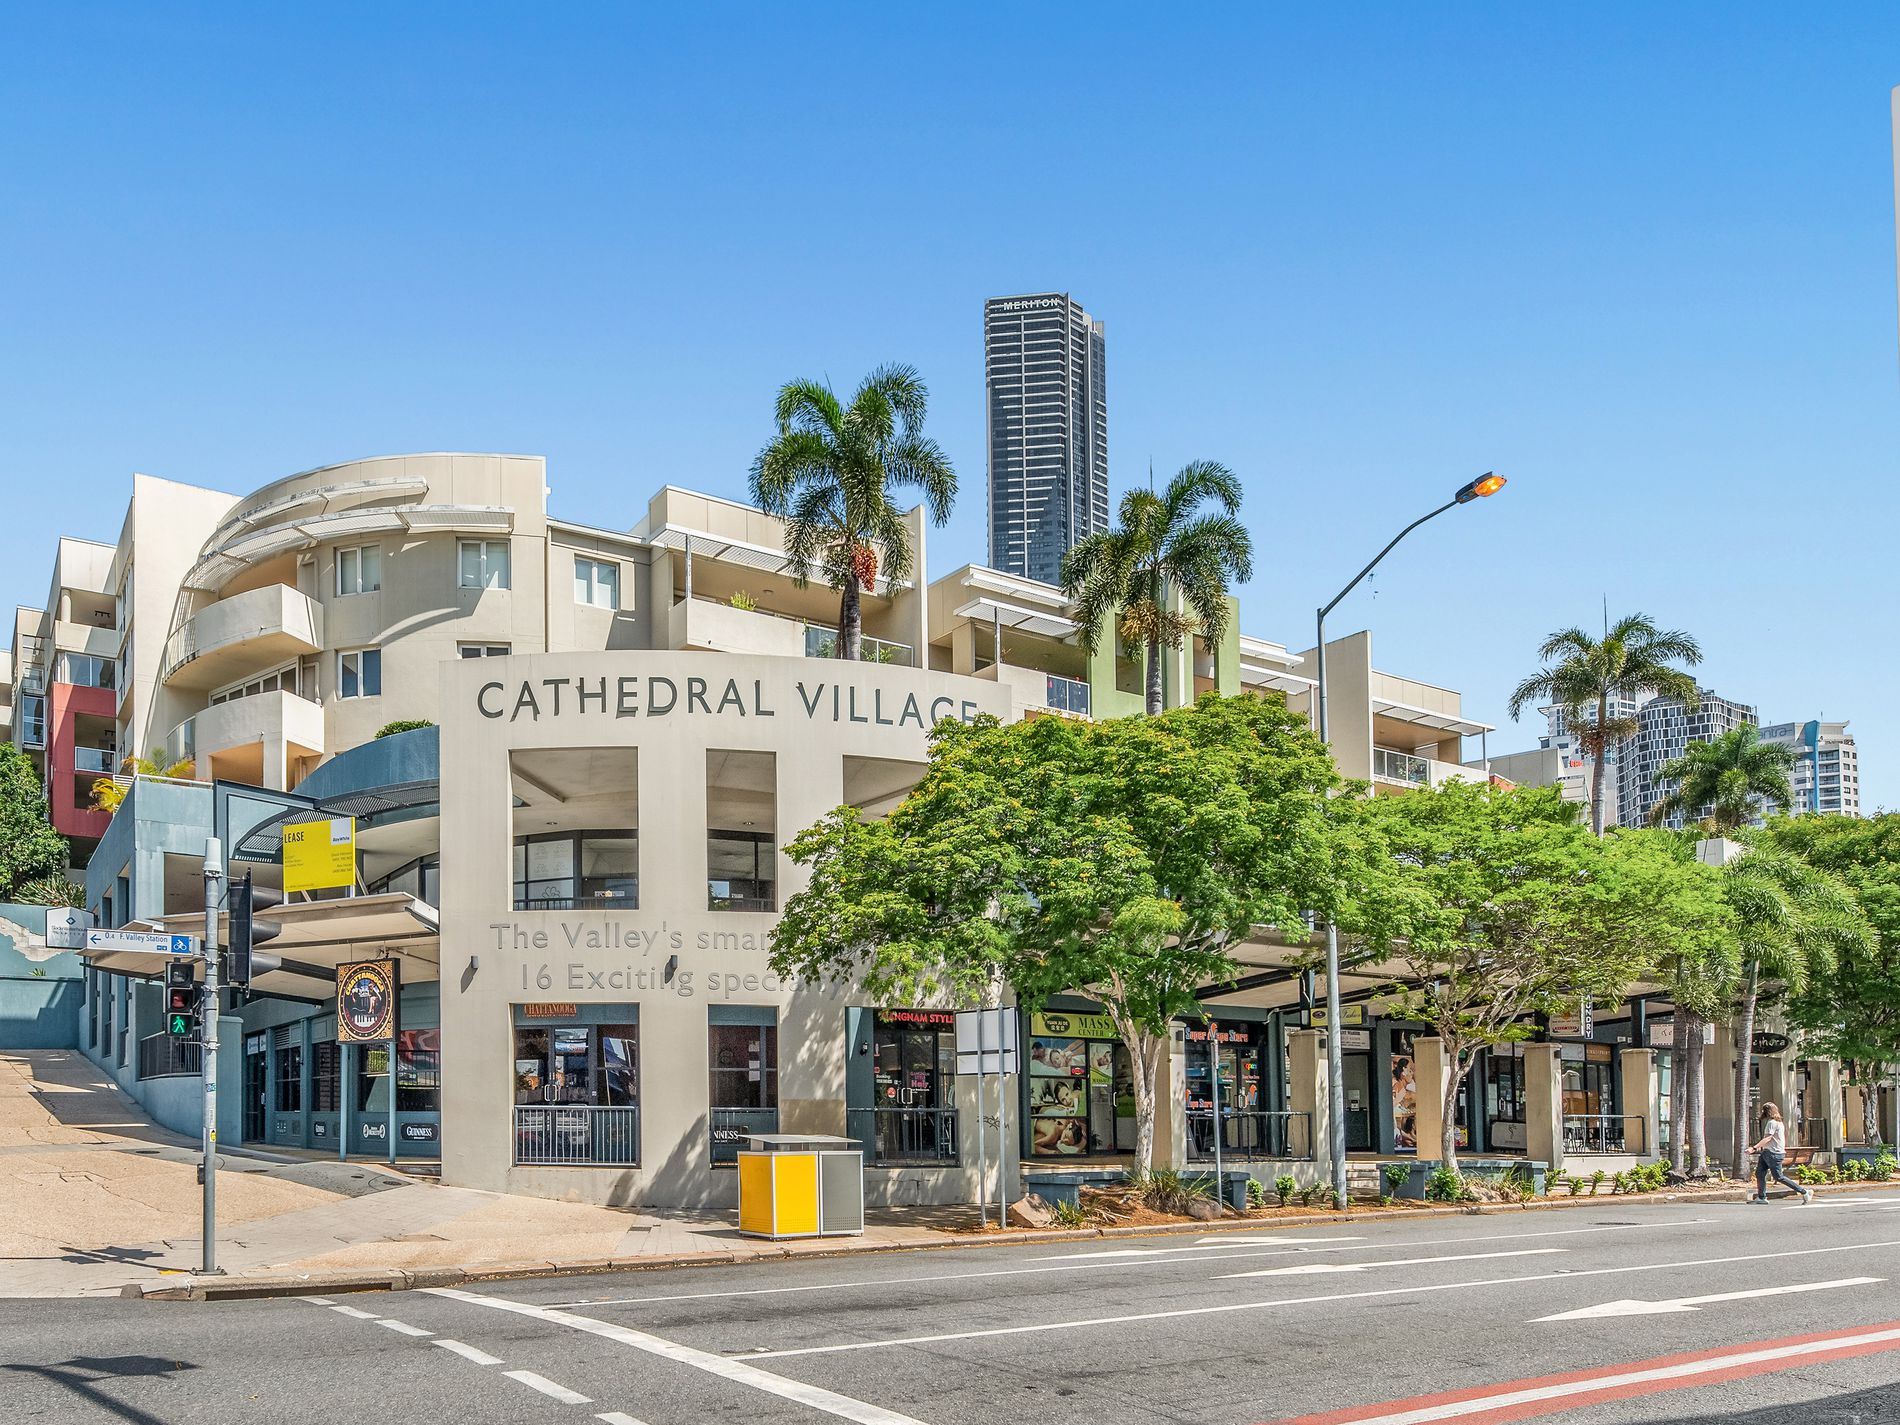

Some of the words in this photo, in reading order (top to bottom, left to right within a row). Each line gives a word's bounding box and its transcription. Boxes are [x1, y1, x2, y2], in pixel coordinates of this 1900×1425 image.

[1003, 298, 1058, 311] MERITON
[477, 676, 775, 722] CATHEDRAL
[797, 682, 978, 728] VILLAGE
[284, 831, 305, 844] LEASE
[126, 933, 145, 942] Valley
[146, 934, 168, 943] Station
[490, 922, 549, 949] The
[561, 921, 684, 956] Valley's
[521, 963, 553, 990] 16
[567, 963, 694, 997] Exciting
[929, 1013, 954, 1024] STYLE
[1079, 1029, 1104, 1037] CENTER
[1185, 1026, 1207, 1043] Super
[1228, 1029, 1249, 1043] Store
[406, 1126, 433, 1138] GUINNESS
